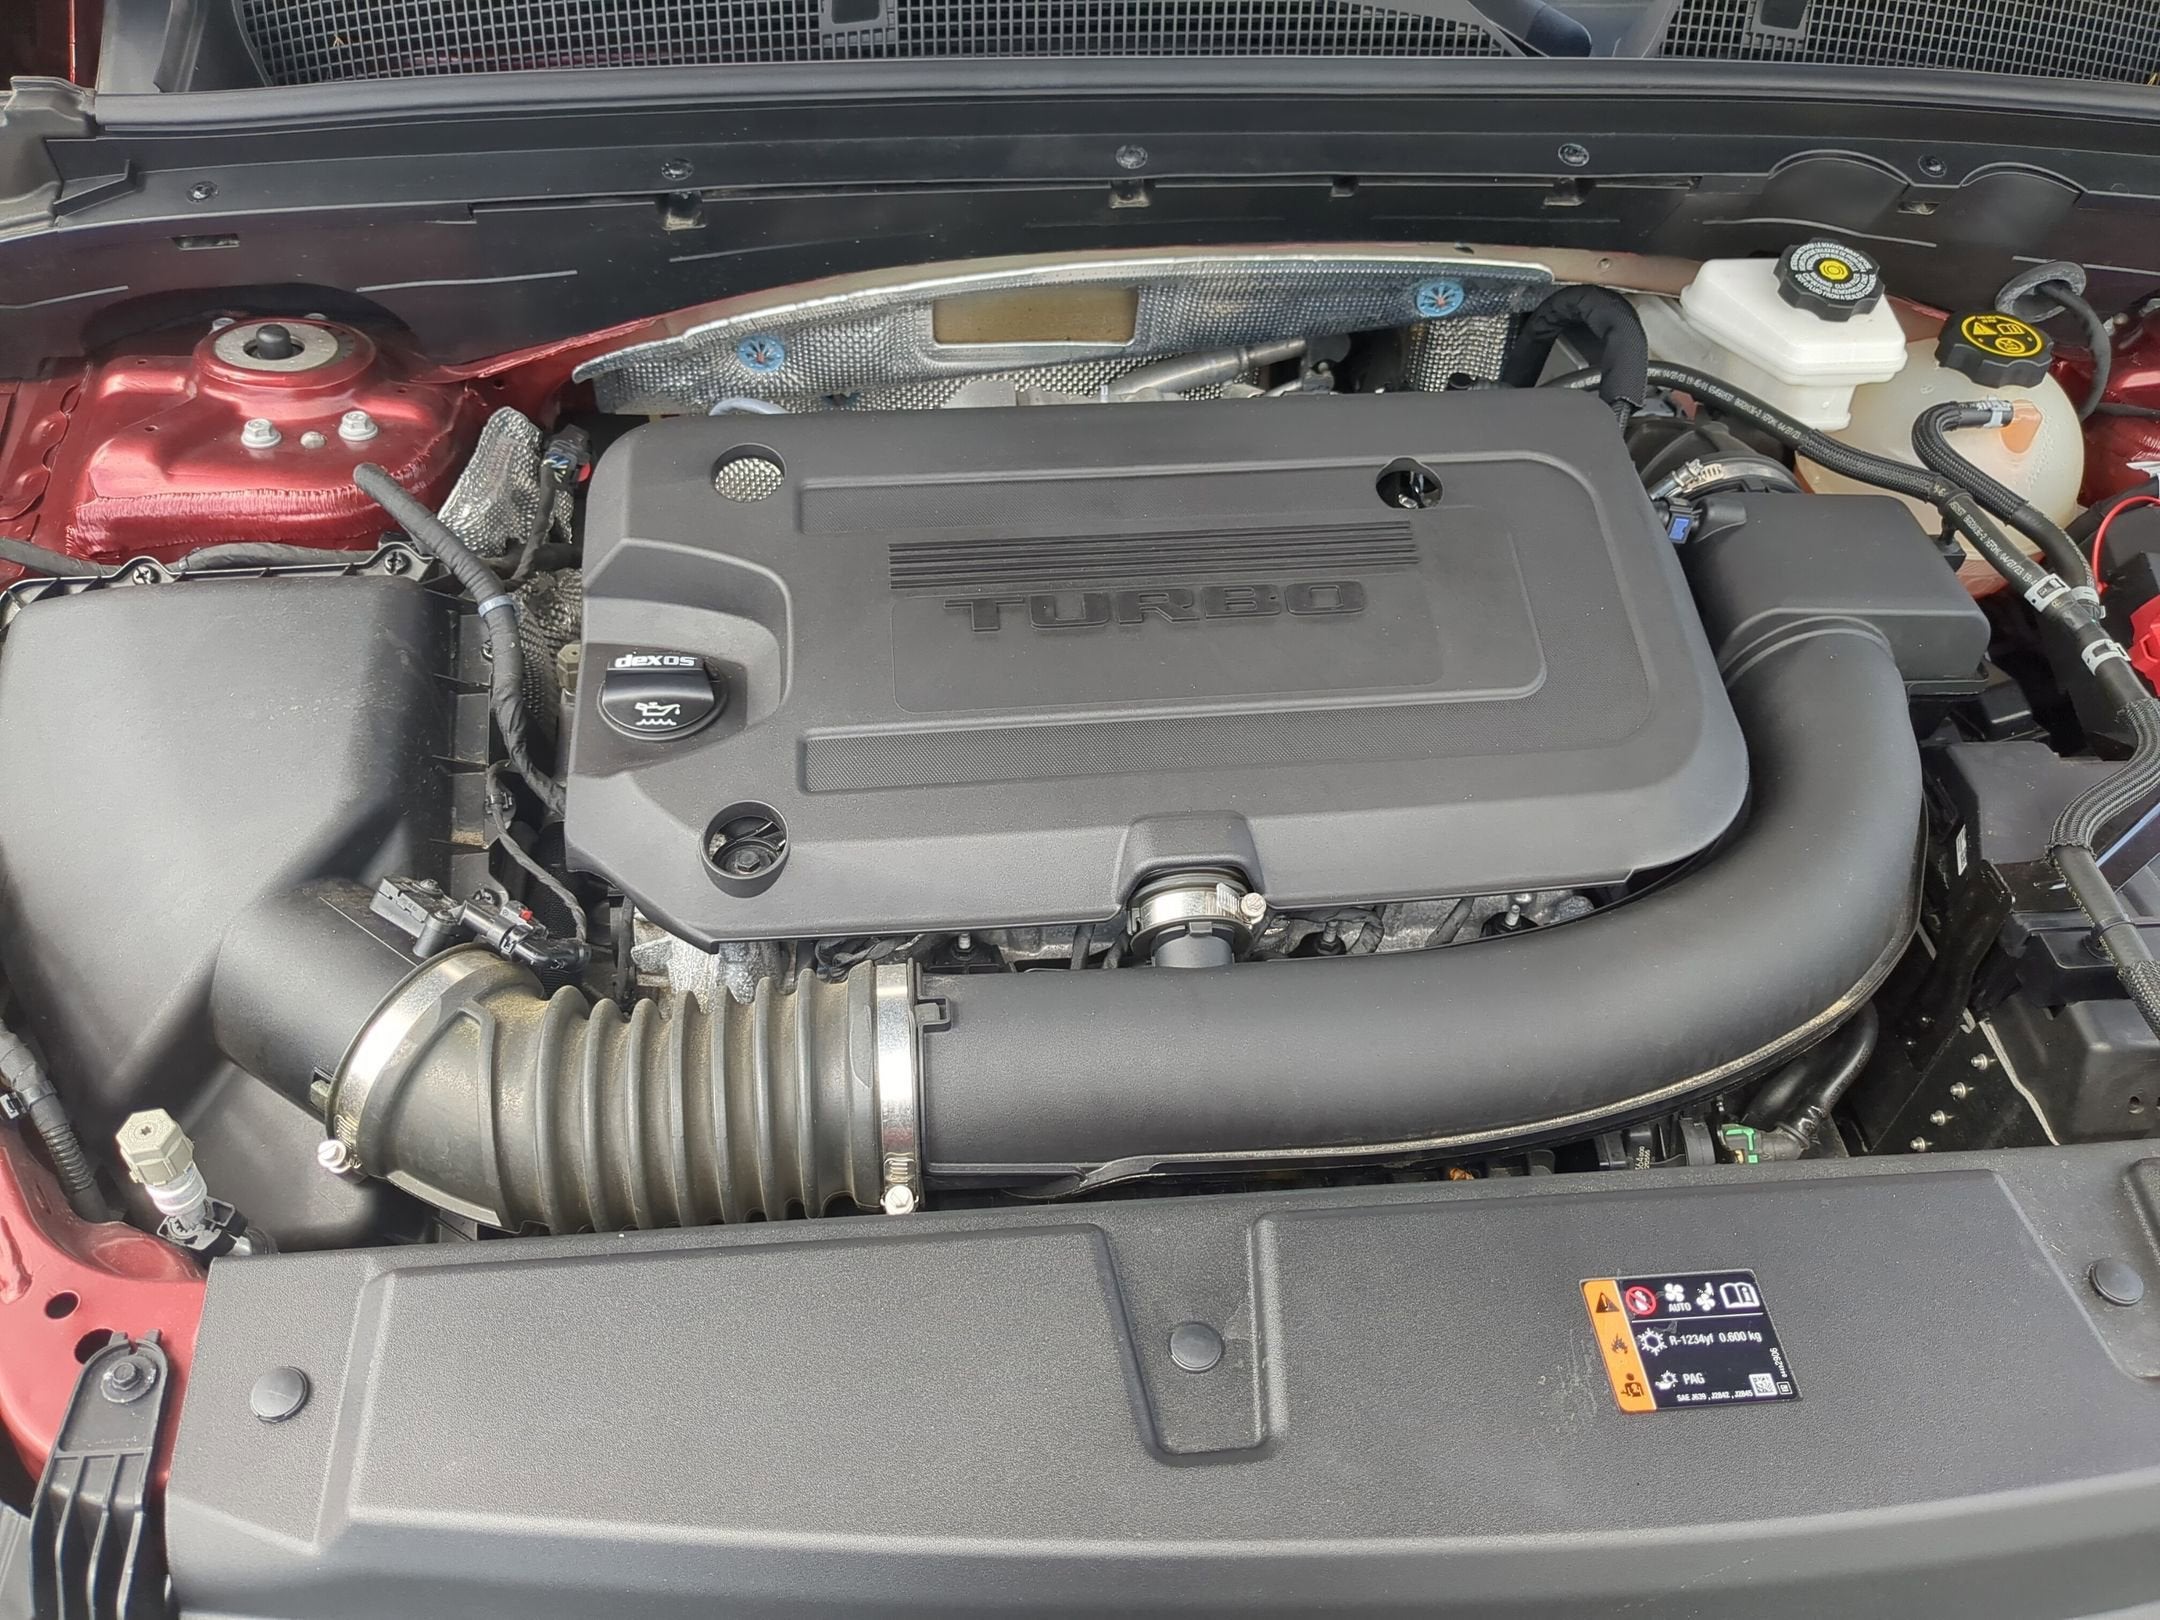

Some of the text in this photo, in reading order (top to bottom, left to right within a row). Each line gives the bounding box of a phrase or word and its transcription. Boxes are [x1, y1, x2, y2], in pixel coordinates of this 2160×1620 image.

[943, 579, 1369, 632] TURBO
[614, 652, 698, 668] dexos
[1668, 1302, 1692, 1313] AUTO
[1668, 1331, 1763, 1346] R-1234yf 0.600 kg
[1682, 1372, 1706, 1385] PAG
[1676, 1394, 1690, 1402] SAE
